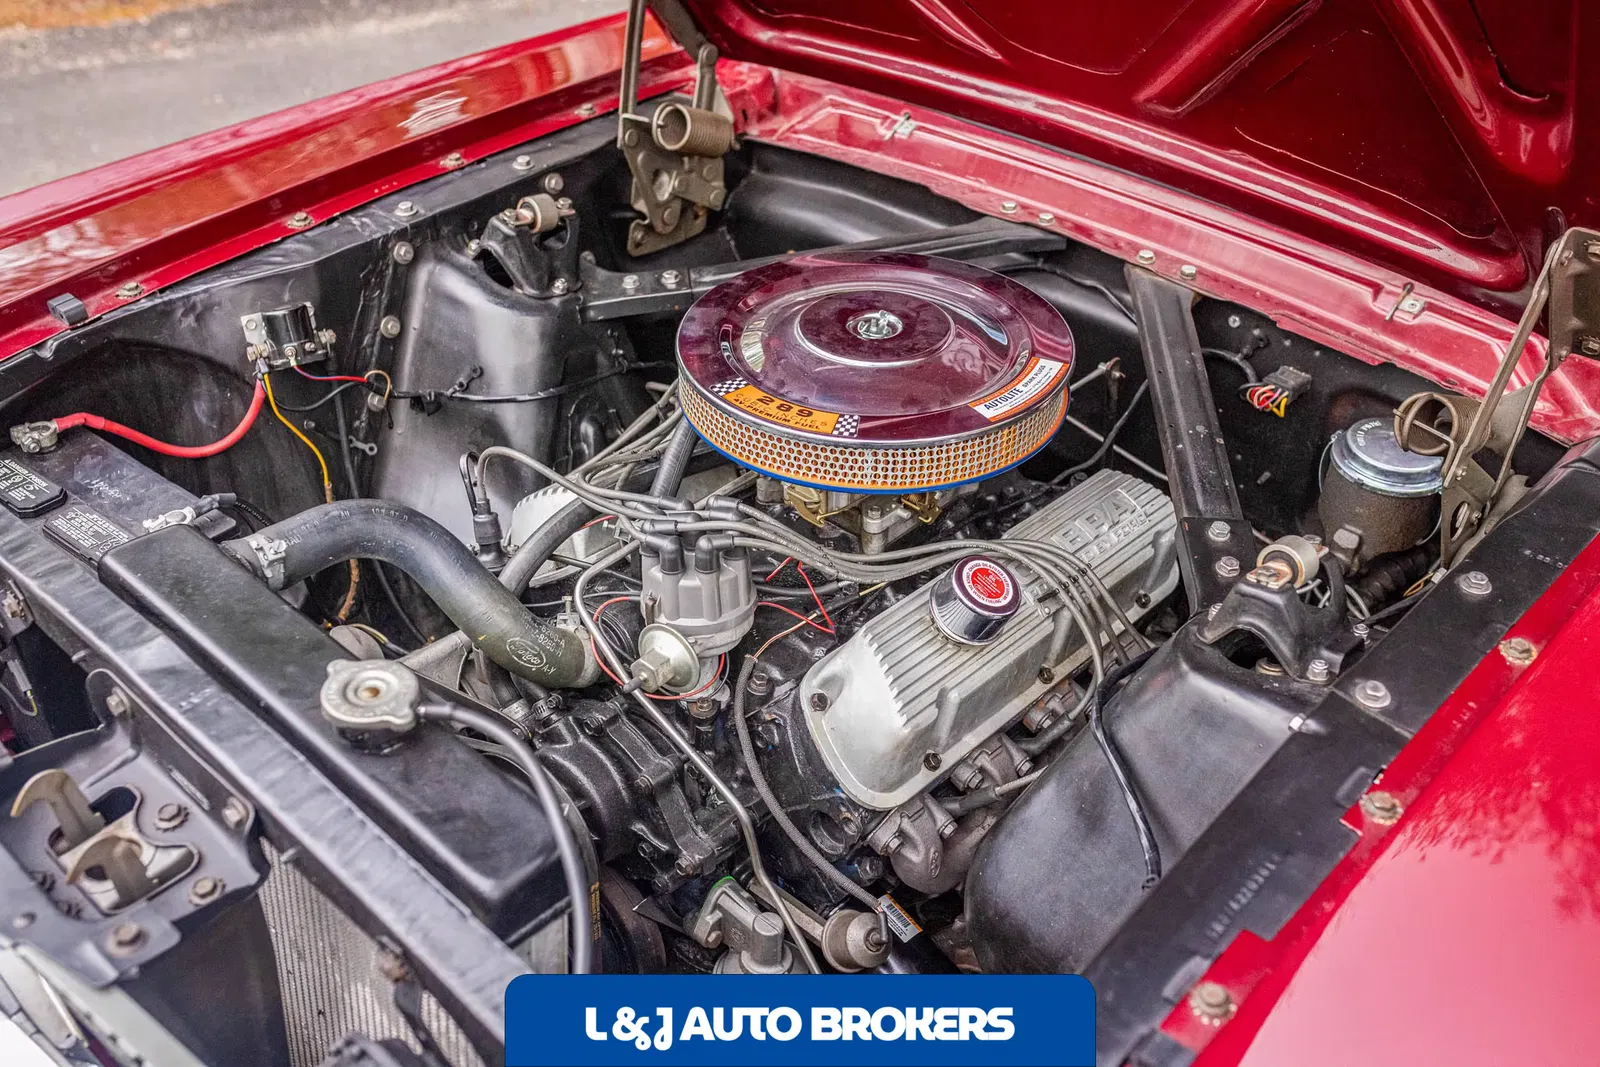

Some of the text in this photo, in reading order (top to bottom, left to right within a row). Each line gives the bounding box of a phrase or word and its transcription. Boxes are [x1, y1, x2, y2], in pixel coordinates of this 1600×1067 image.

[736, 393, 828, 426] CUBIC INCHES
[757, 395, 814, 418] 289
[984, 387, 1024, 411] AUTOLITE
[794, 420, 821, 430] FUEL
